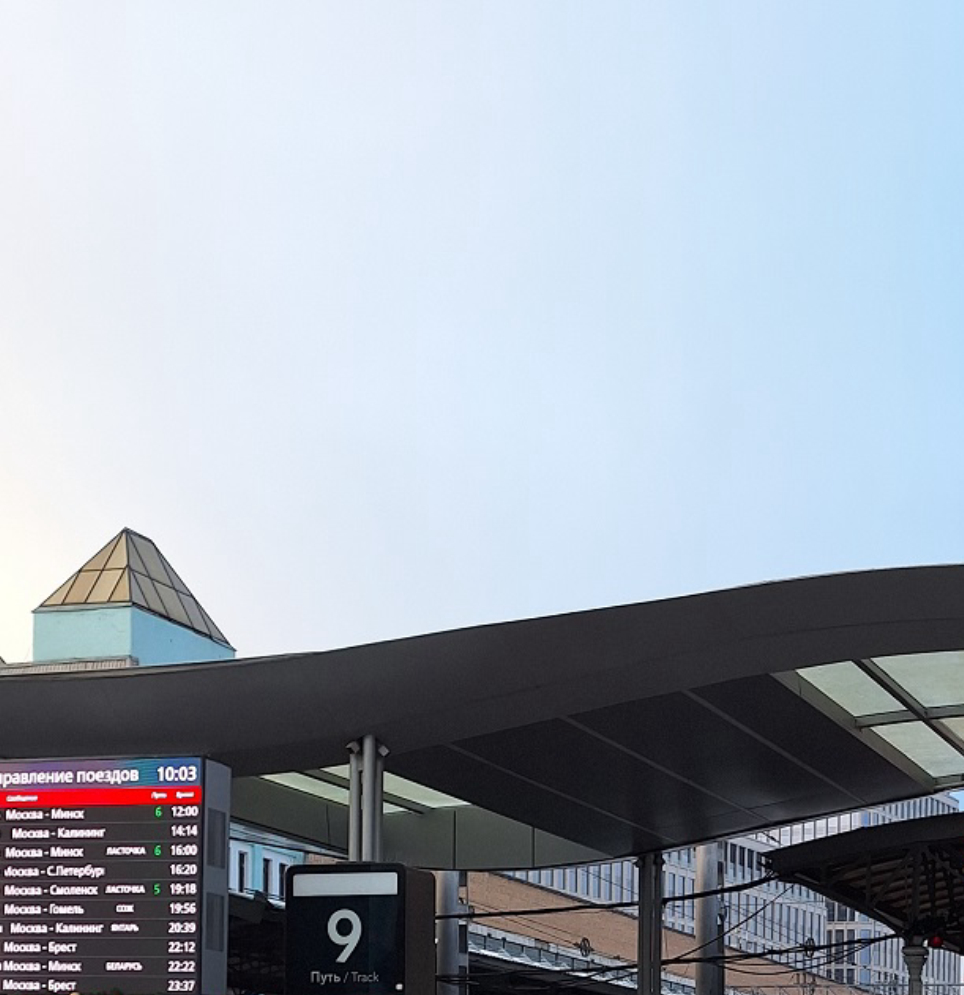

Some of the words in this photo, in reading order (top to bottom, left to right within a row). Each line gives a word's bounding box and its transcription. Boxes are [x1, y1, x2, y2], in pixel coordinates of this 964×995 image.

[77, 769, 139, 785] поездов
[157, 766, 197, 782] 10:03
[6, 809, 43, 820] Москва
[51, 809, 84, 820] Минск
[155, 807, 162, 817] 6
[171, 806, 199, 817] 12:00
[12, 828, 49, 839] Москва
[171, 825, 198, 837] 14:14
[5, 847, 43, 858] Москва
[50, 846, 84, 858] Минск
[105, 847, 146, 855] ЛАСТОЧКА
[154, 846, 162, 855] 6
[170, 845, 198, 856] 16:00
[170, 864, 197, 875] 16:20
[4, 885, 42, 896] Москва
[49, 885, 98, 896] Смоленск
[105, 885, 145, 894] ЛАСТОЧКА
[153, 884, 160, 895] 5
[170, 884, 197, 895] 19:18
[4, 904, 42, 915] Москва
[49, 904, 84, 915] Гомель
[169, 903, 197, 914] 19:56
[10, 923, 48, 934] Москва
[168, 922, 196, 934] 20:39
[327, 909, 362, 963] 9
[4, 942, 41, 953] Москва
[48, 941, 77, 955] Брест
[168, 942, 195, 953] 22:12
[3, 961, 41, 972] Москва
[48, 961, 82, 972] Минск
[168, 961, 195, 972] 22:22
[310, 971, 341, 985] Путь
[351, 970, 379, 983] Track
[3, 980, 40, 991] Москва
[48, 980, 76, 993] Брест
[167, 981, 195, 991] 23:37
